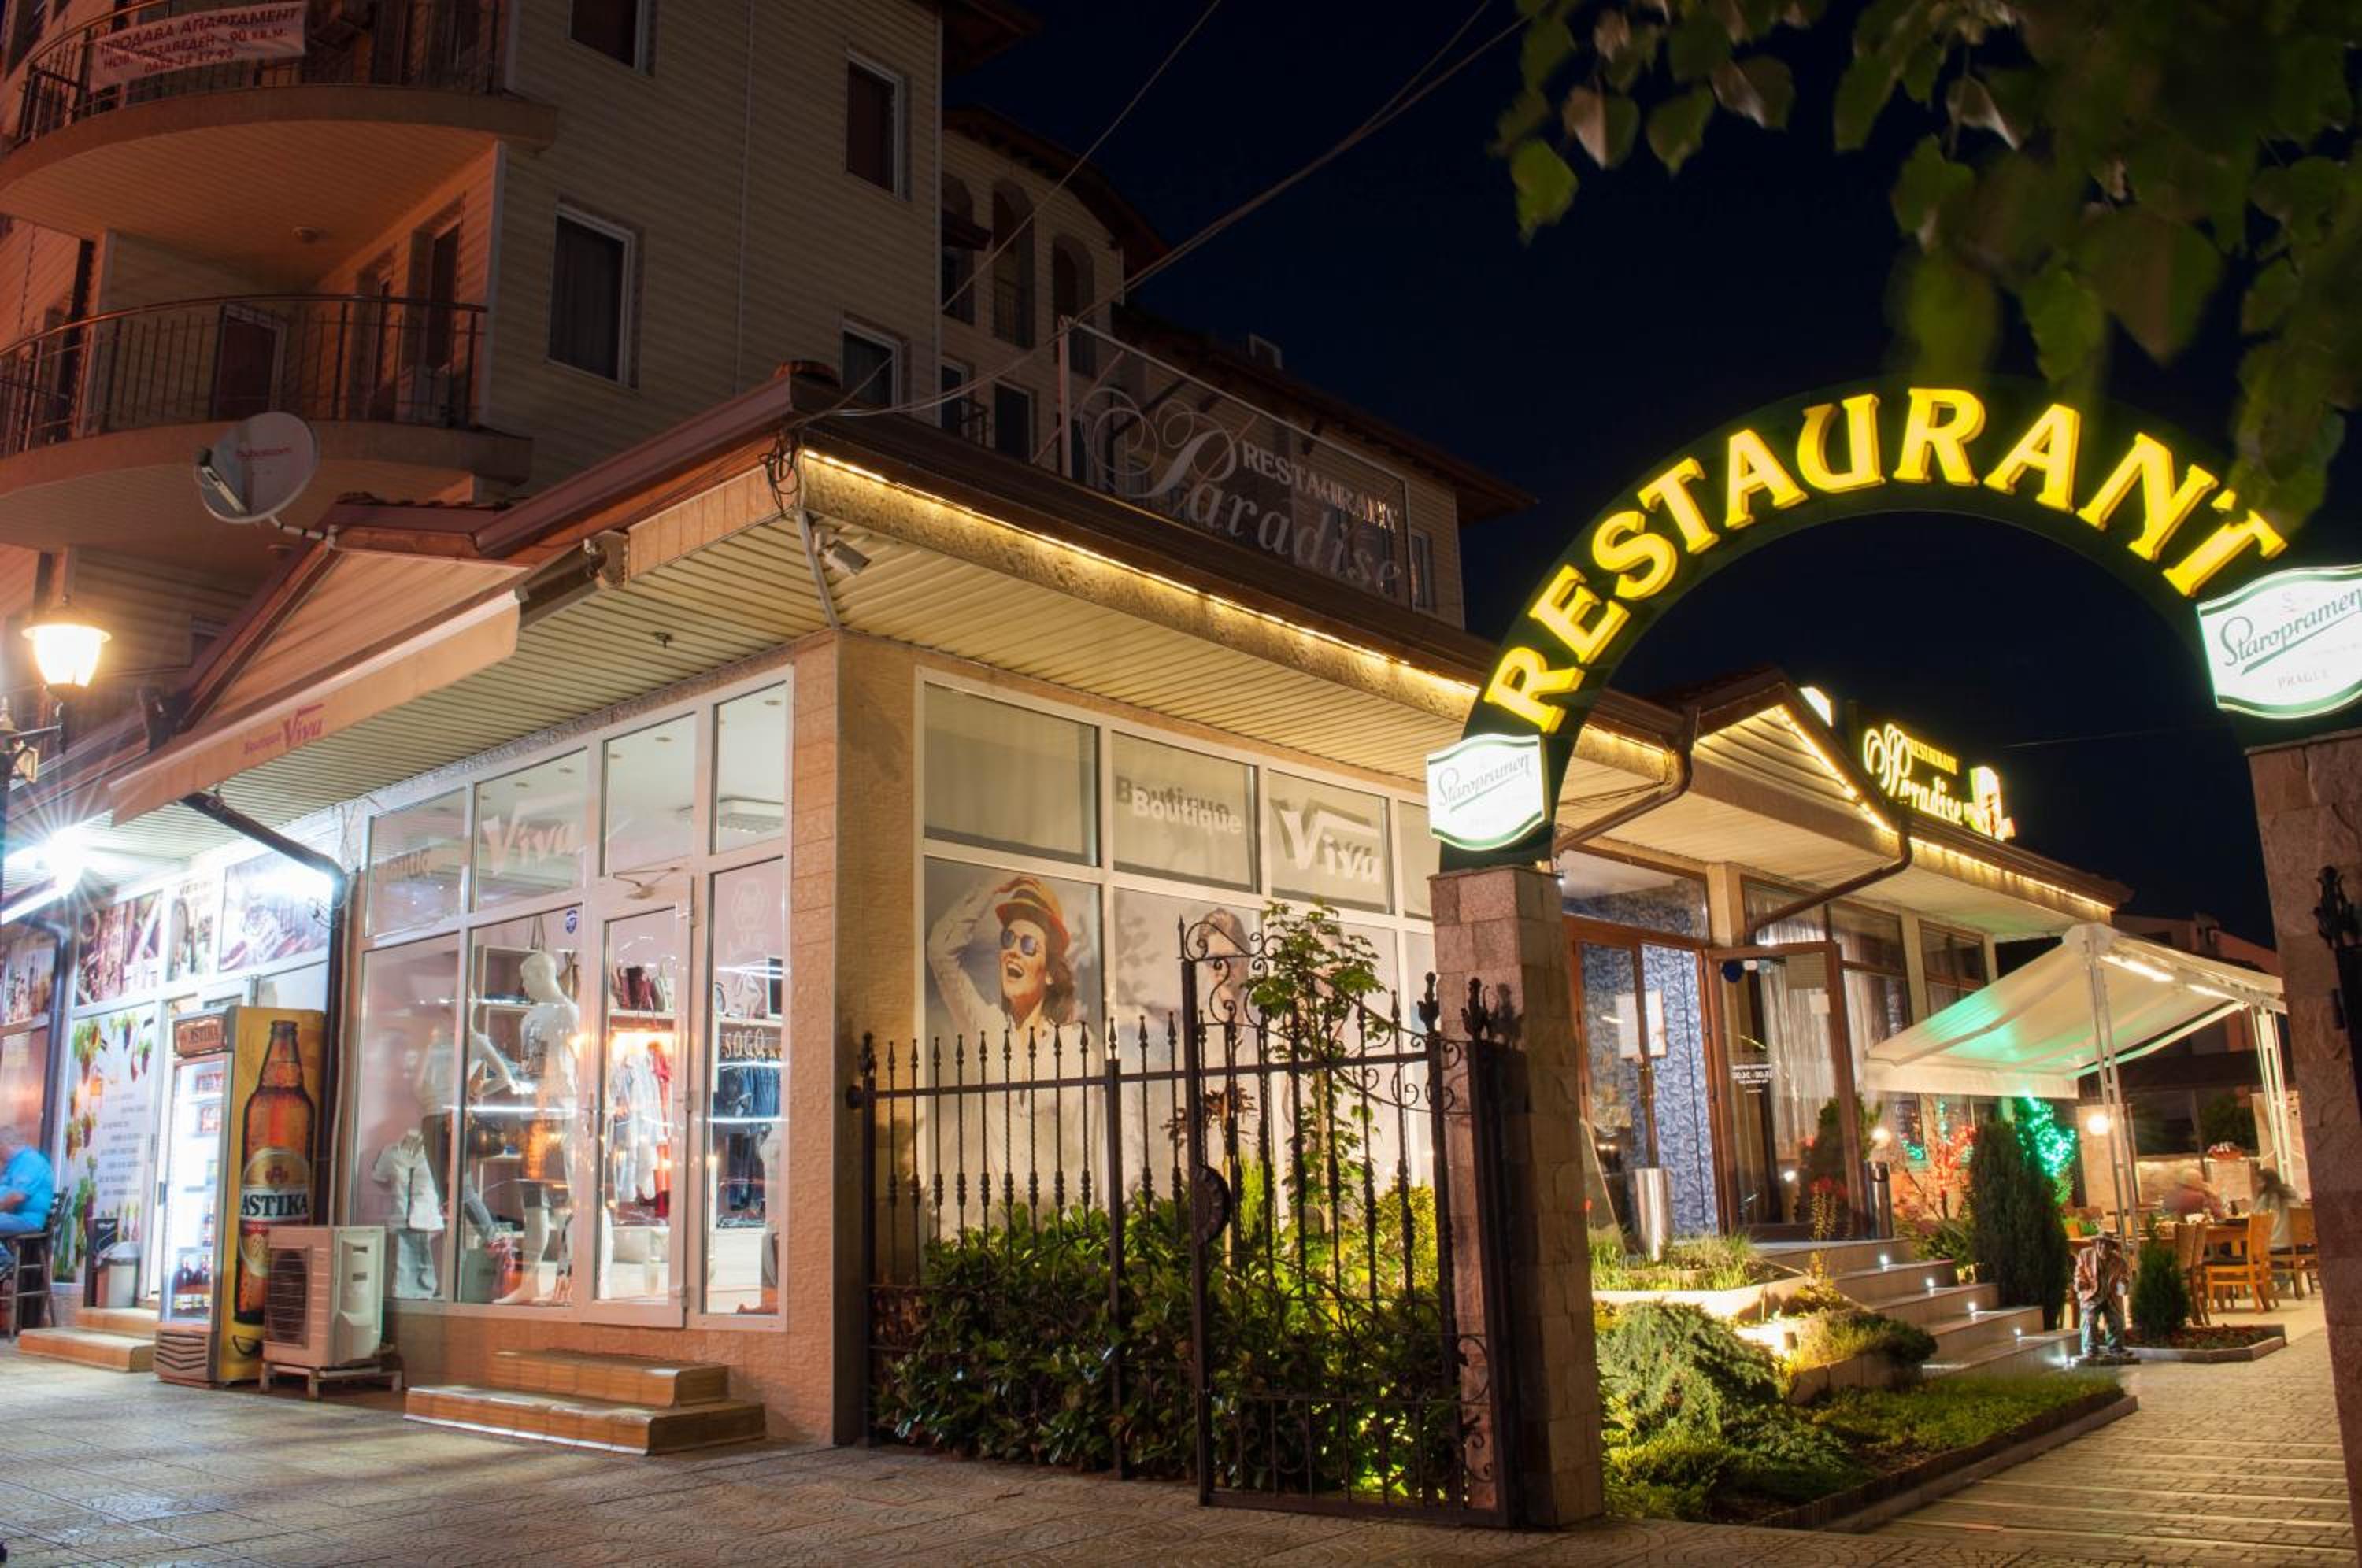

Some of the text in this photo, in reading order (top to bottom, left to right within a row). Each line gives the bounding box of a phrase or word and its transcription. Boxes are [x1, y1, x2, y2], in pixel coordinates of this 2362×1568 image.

[1079, 386, 1403, 597] Paradise
[1241, 439, 1398, 534] RESTAURANT
[1483, 386, 2287, 734] RESTAURANT
[2220, 588, 2362, 667] Staropramen
[283, 703, 324, 751] Viva
[1438, 753, 1531, 808] Staropramen
[1132, 790, 1382, 884] Boutique Viva
[240, 1193, 309, 1217] ASTIKA
